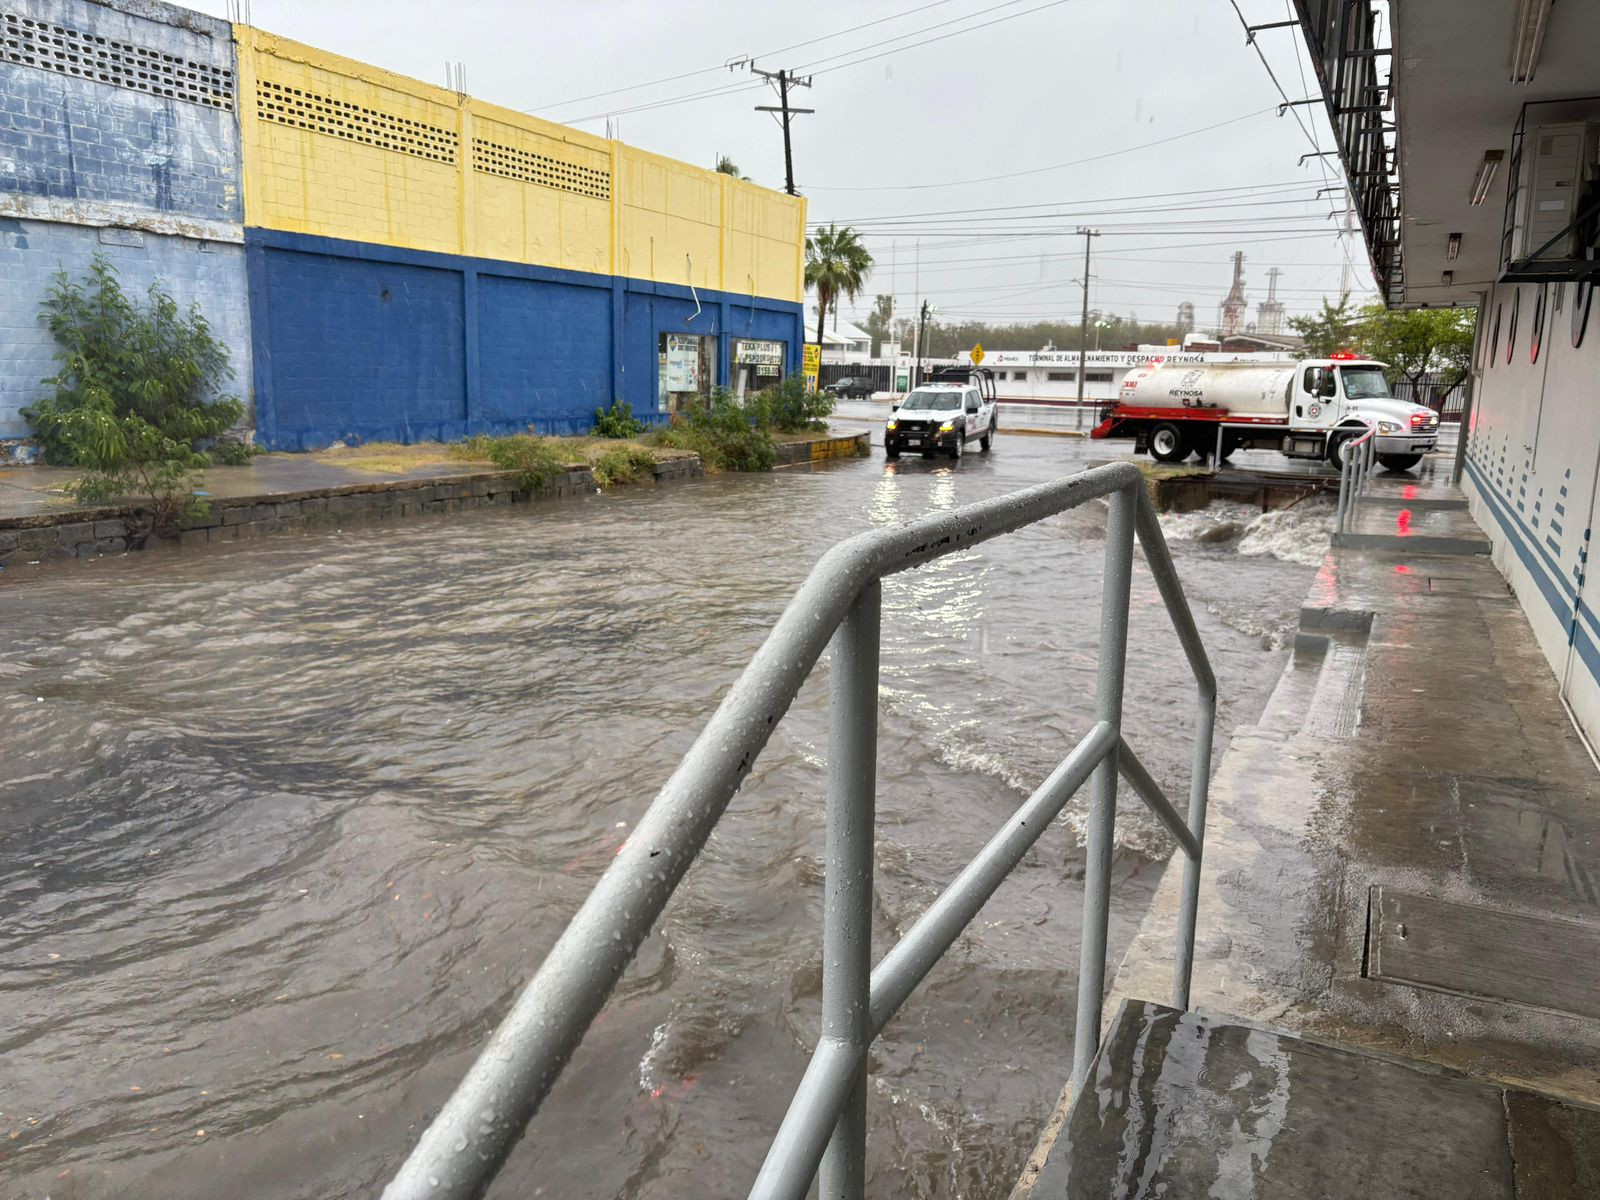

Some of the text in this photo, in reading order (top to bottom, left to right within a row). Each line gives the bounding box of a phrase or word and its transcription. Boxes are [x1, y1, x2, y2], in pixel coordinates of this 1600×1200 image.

[1029, 354, 1055, 362] TERMINAL
[1056, 354, 1063, 362] DE
[1064, 354, 1119, 363] ALMAENAMIENTO
[1127, 355, 1165, 363] DESPACHO
[1167, 355, 1204, 363] REYNOSA
[1169, 389, 1203, 397] REYNOSA
